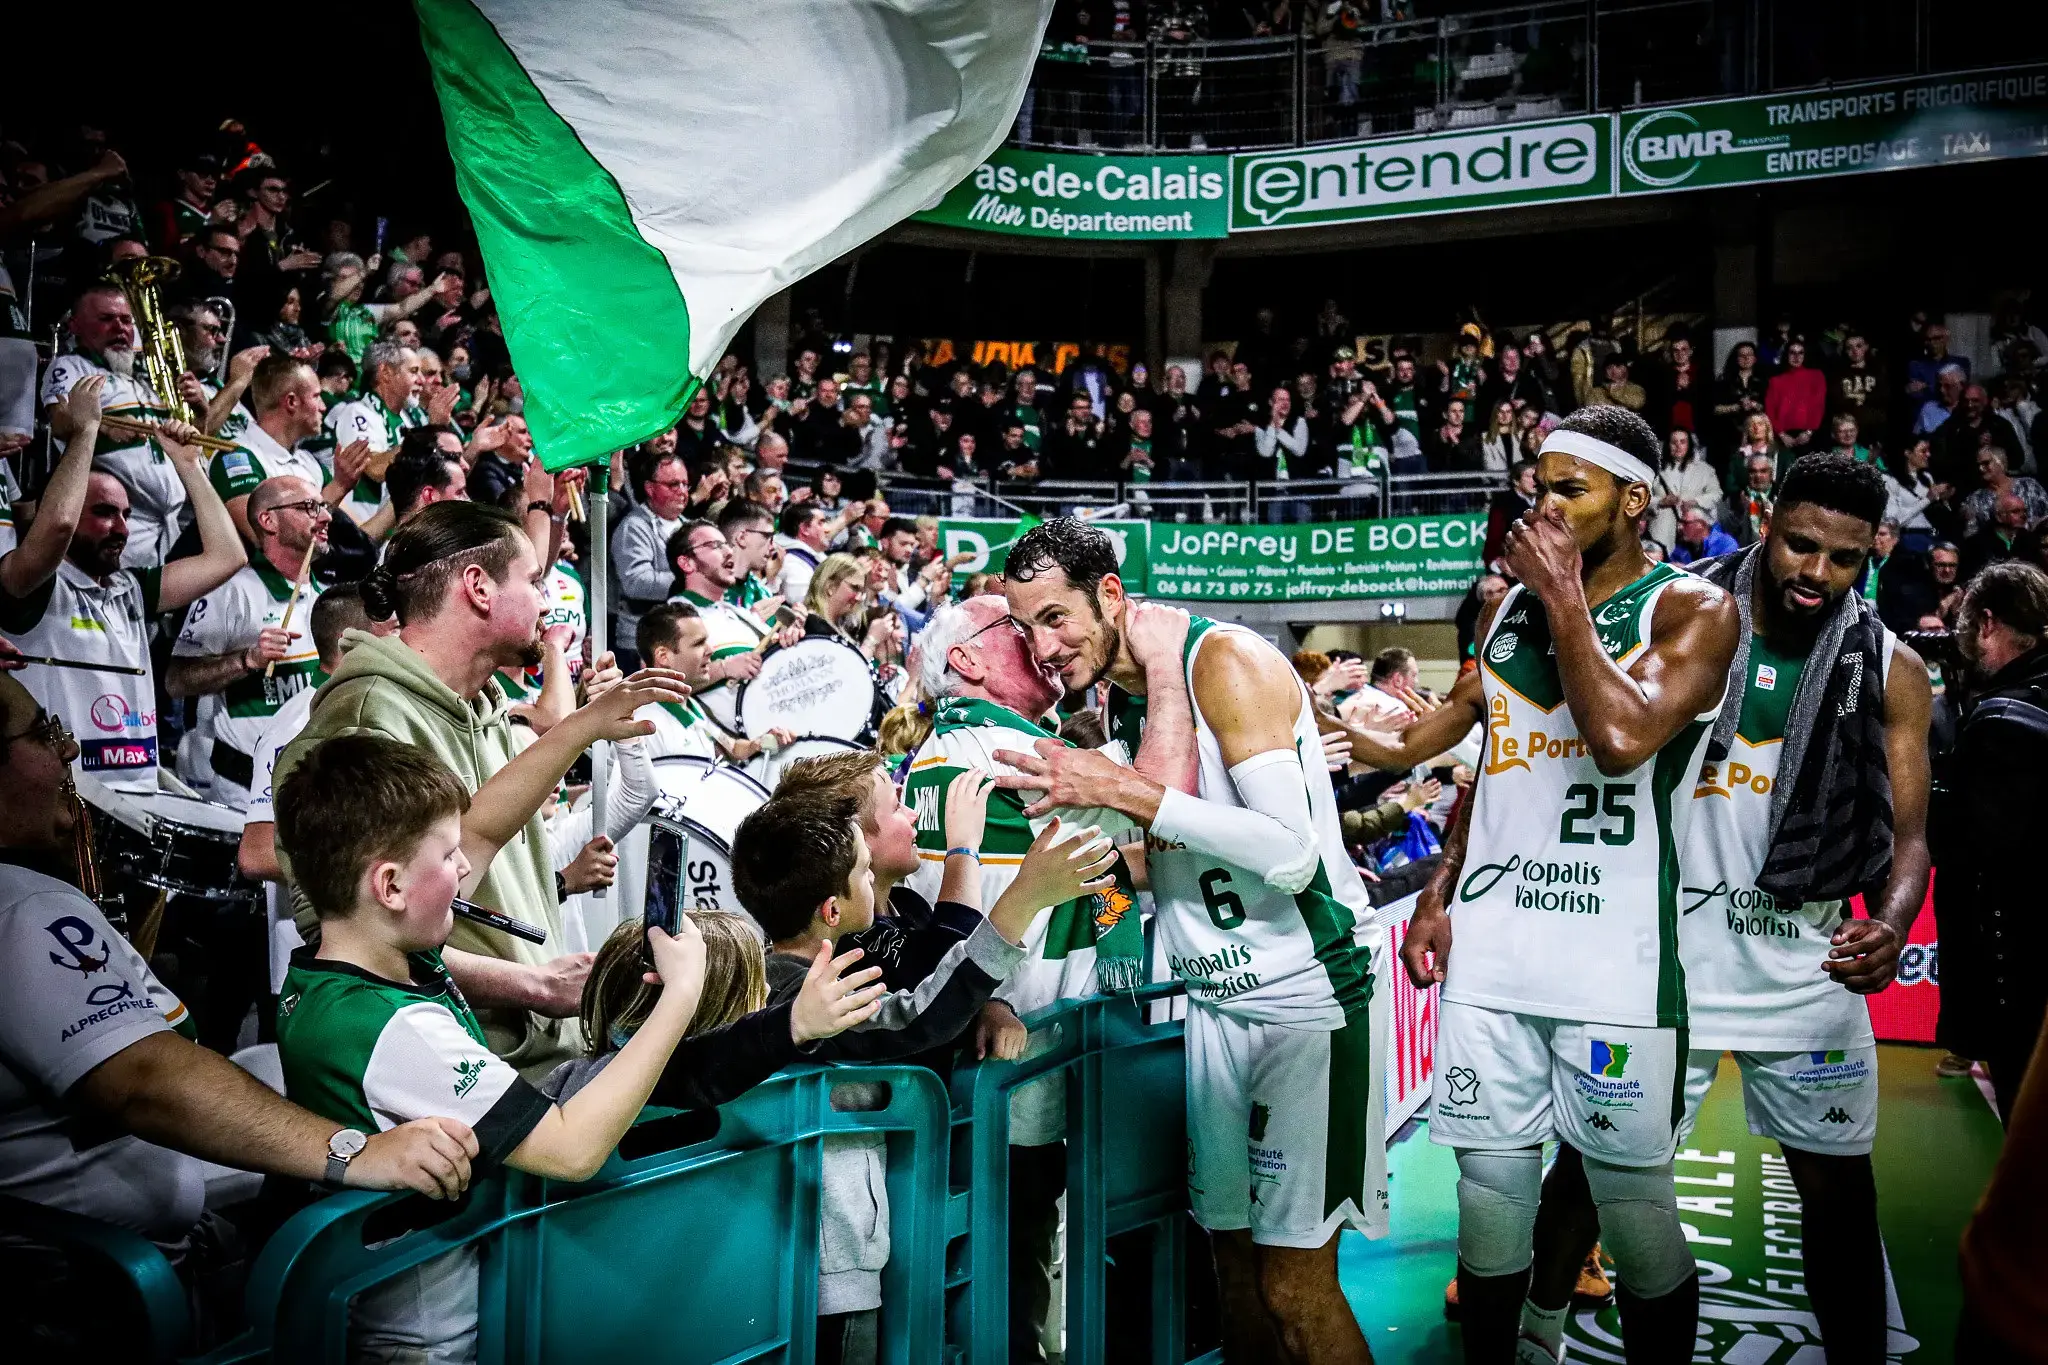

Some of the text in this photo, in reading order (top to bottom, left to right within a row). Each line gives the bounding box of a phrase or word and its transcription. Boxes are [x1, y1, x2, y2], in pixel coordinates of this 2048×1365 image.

[1766, 91, 1896, 127] TRANSPORTS
[1639, 129, 1735, 162] BMR
[1766, 137, 1920, 173] ENTREPOSAGE
[1256, 137, 1589, 204] entendre
[968, 193, 1193, 235] Mon Département
[1161, 530, 1297, 563] Joffrey
[1311, 527, 1355, 555] DE
[1369, 520, 1489, 551] BOECK
[1157, 580, 1178, 594] 06
[1181, 581, 1201, 594] 84
[1206, 582, 1225, 595] 73
[1229, 582, 1250, 595] 89
[1253, 582, 1274, 595] 75
[103, 748, 148, 765] Max
[1559, 783, 1637, 846] 25
[1523, 860, 1601, 887] Copalis
[1198, 867, 1247, 931] 6
[1515, 885, 1600, 914] Valofish
[1726, 909, 1800, 938] Valofish
[62, 1001, 130, 1042] ALPRECH
[454, 1060, 487, 1096] Airspire
[1573, 1073, 1644, 1099] d'agglomération
[1579, 1070, 1640, 1090] Communauté
[1438, 1109, 1490, 1120] Hauts-de-France
